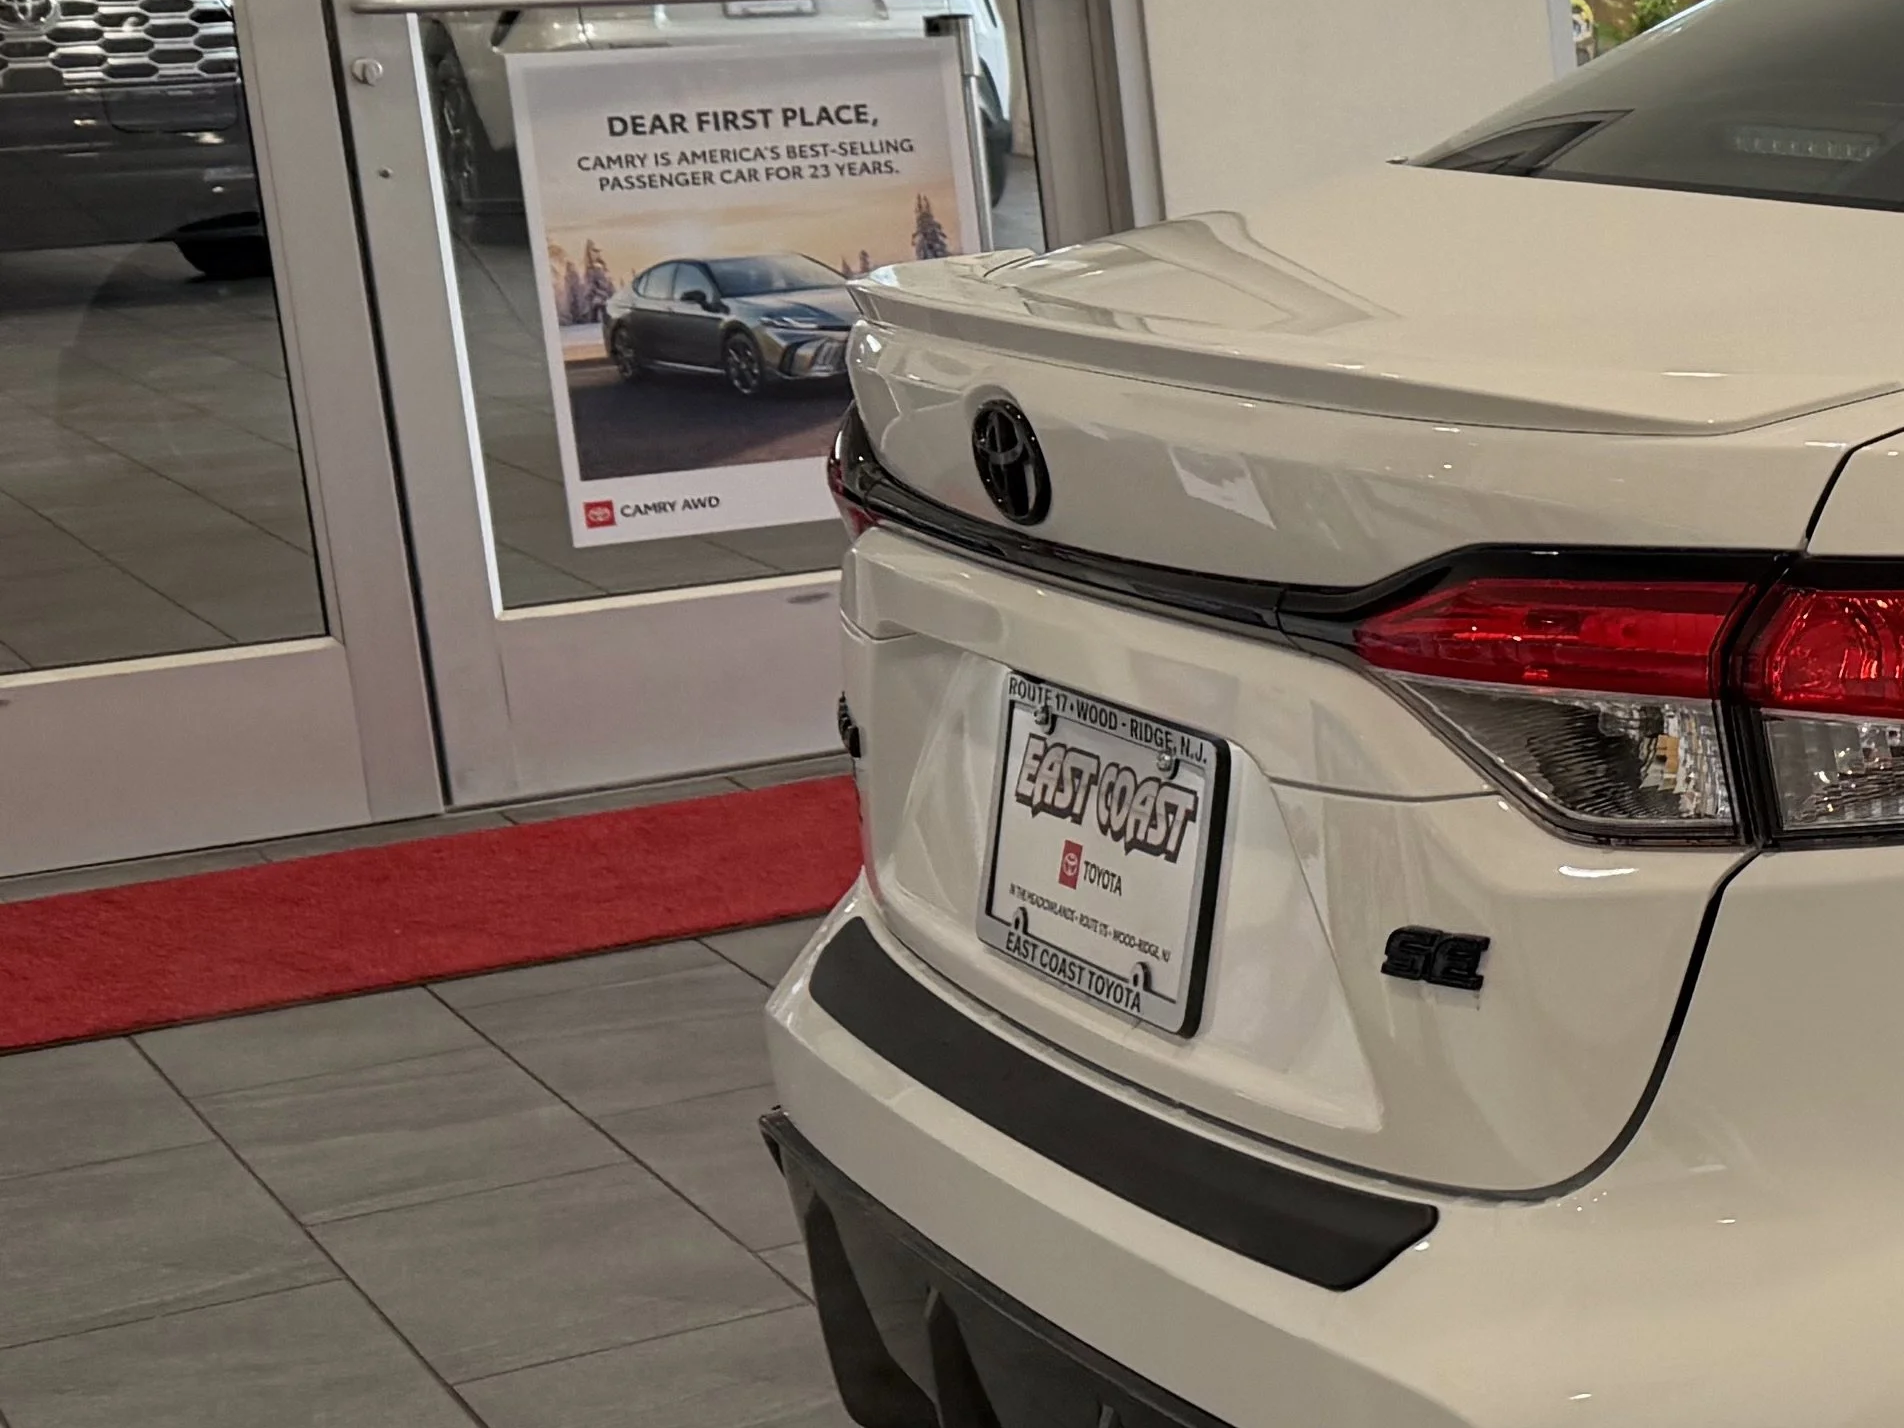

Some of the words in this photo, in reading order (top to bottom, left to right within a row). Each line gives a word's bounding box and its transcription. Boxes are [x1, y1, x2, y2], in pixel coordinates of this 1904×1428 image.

[607, 112, 690, 138] DEAR
[698, 108, 773, 133] FIRST
[782, 103, 880, 129] PLACE,
[577, 152, 648, 172] CAMRY
[654, 151, 672, 168] IS
[677, 145, 781, 167] AMERICA'S
[786, 138, 915, 160] BEST-SELLING
[598, 169, 714, 192] PASSENGER
[720, 168, 760, 185] CAR
[765, 165, 804, 182] FOR
[808, 163, 831, 180] 23
[835, 159, 900, 178] YEARS.
[619, 500, 678, 518] CAMRY
[681, 495, 721, 511] AWD
[1008, 676, 1054, 706] ROUTE
[1054, 692, 1069, 713] 17
[1076, 703, 1119, 732] WOOD
[1180, 738, 1208, 765] N.J.
[1015, 732, 1100, 825] EAST
[1096, 761, 1199, 864] COAST
[1082, 860, 1123, 897] TOYOTA
[1005, 931, 1036, 963] EAST
[1040, 946, 1085, 986] COAST
[1089, 964, 1142, 1013] TOYOTA
[1380, 925, 1491, 991] SE
